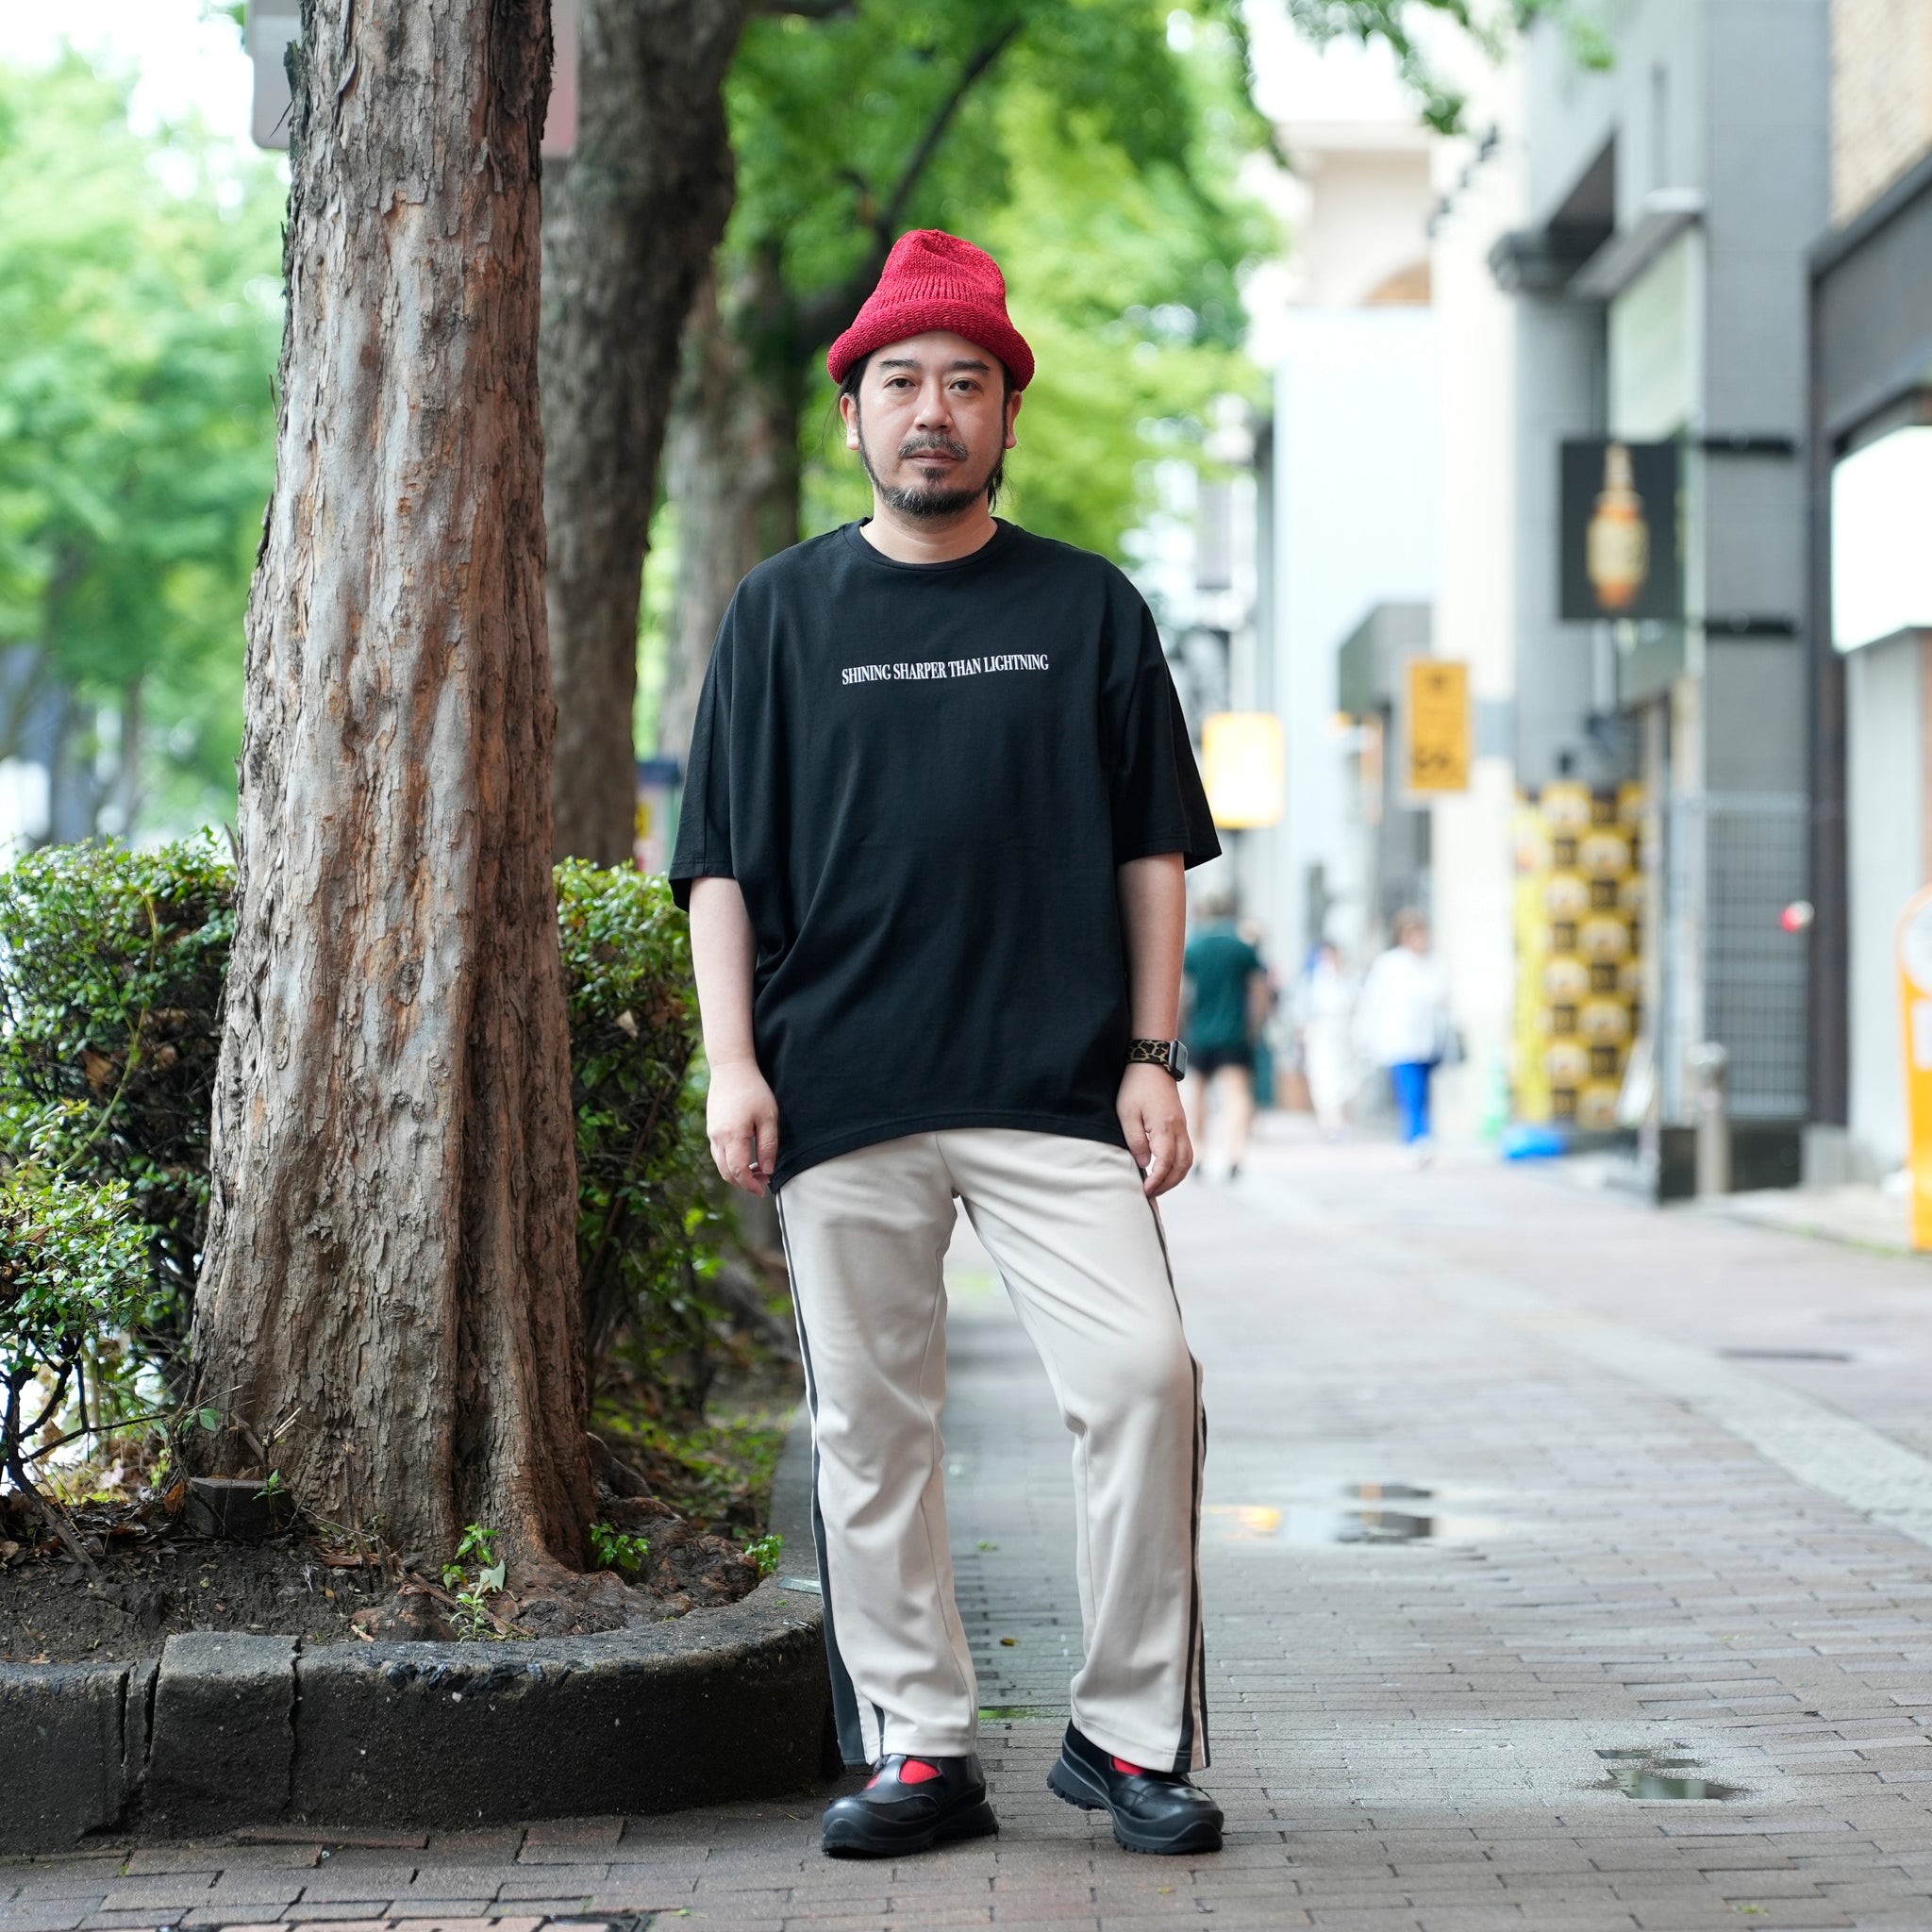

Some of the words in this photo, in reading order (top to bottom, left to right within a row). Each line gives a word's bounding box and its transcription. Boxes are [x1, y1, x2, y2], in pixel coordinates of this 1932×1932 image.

[841, 663, 891, 685] SHINING
[893, 661, 947, 679] SHARPER
[948, 658, 981, 677] THAN
[983, 654, 1049, 673] LIGHTNING
